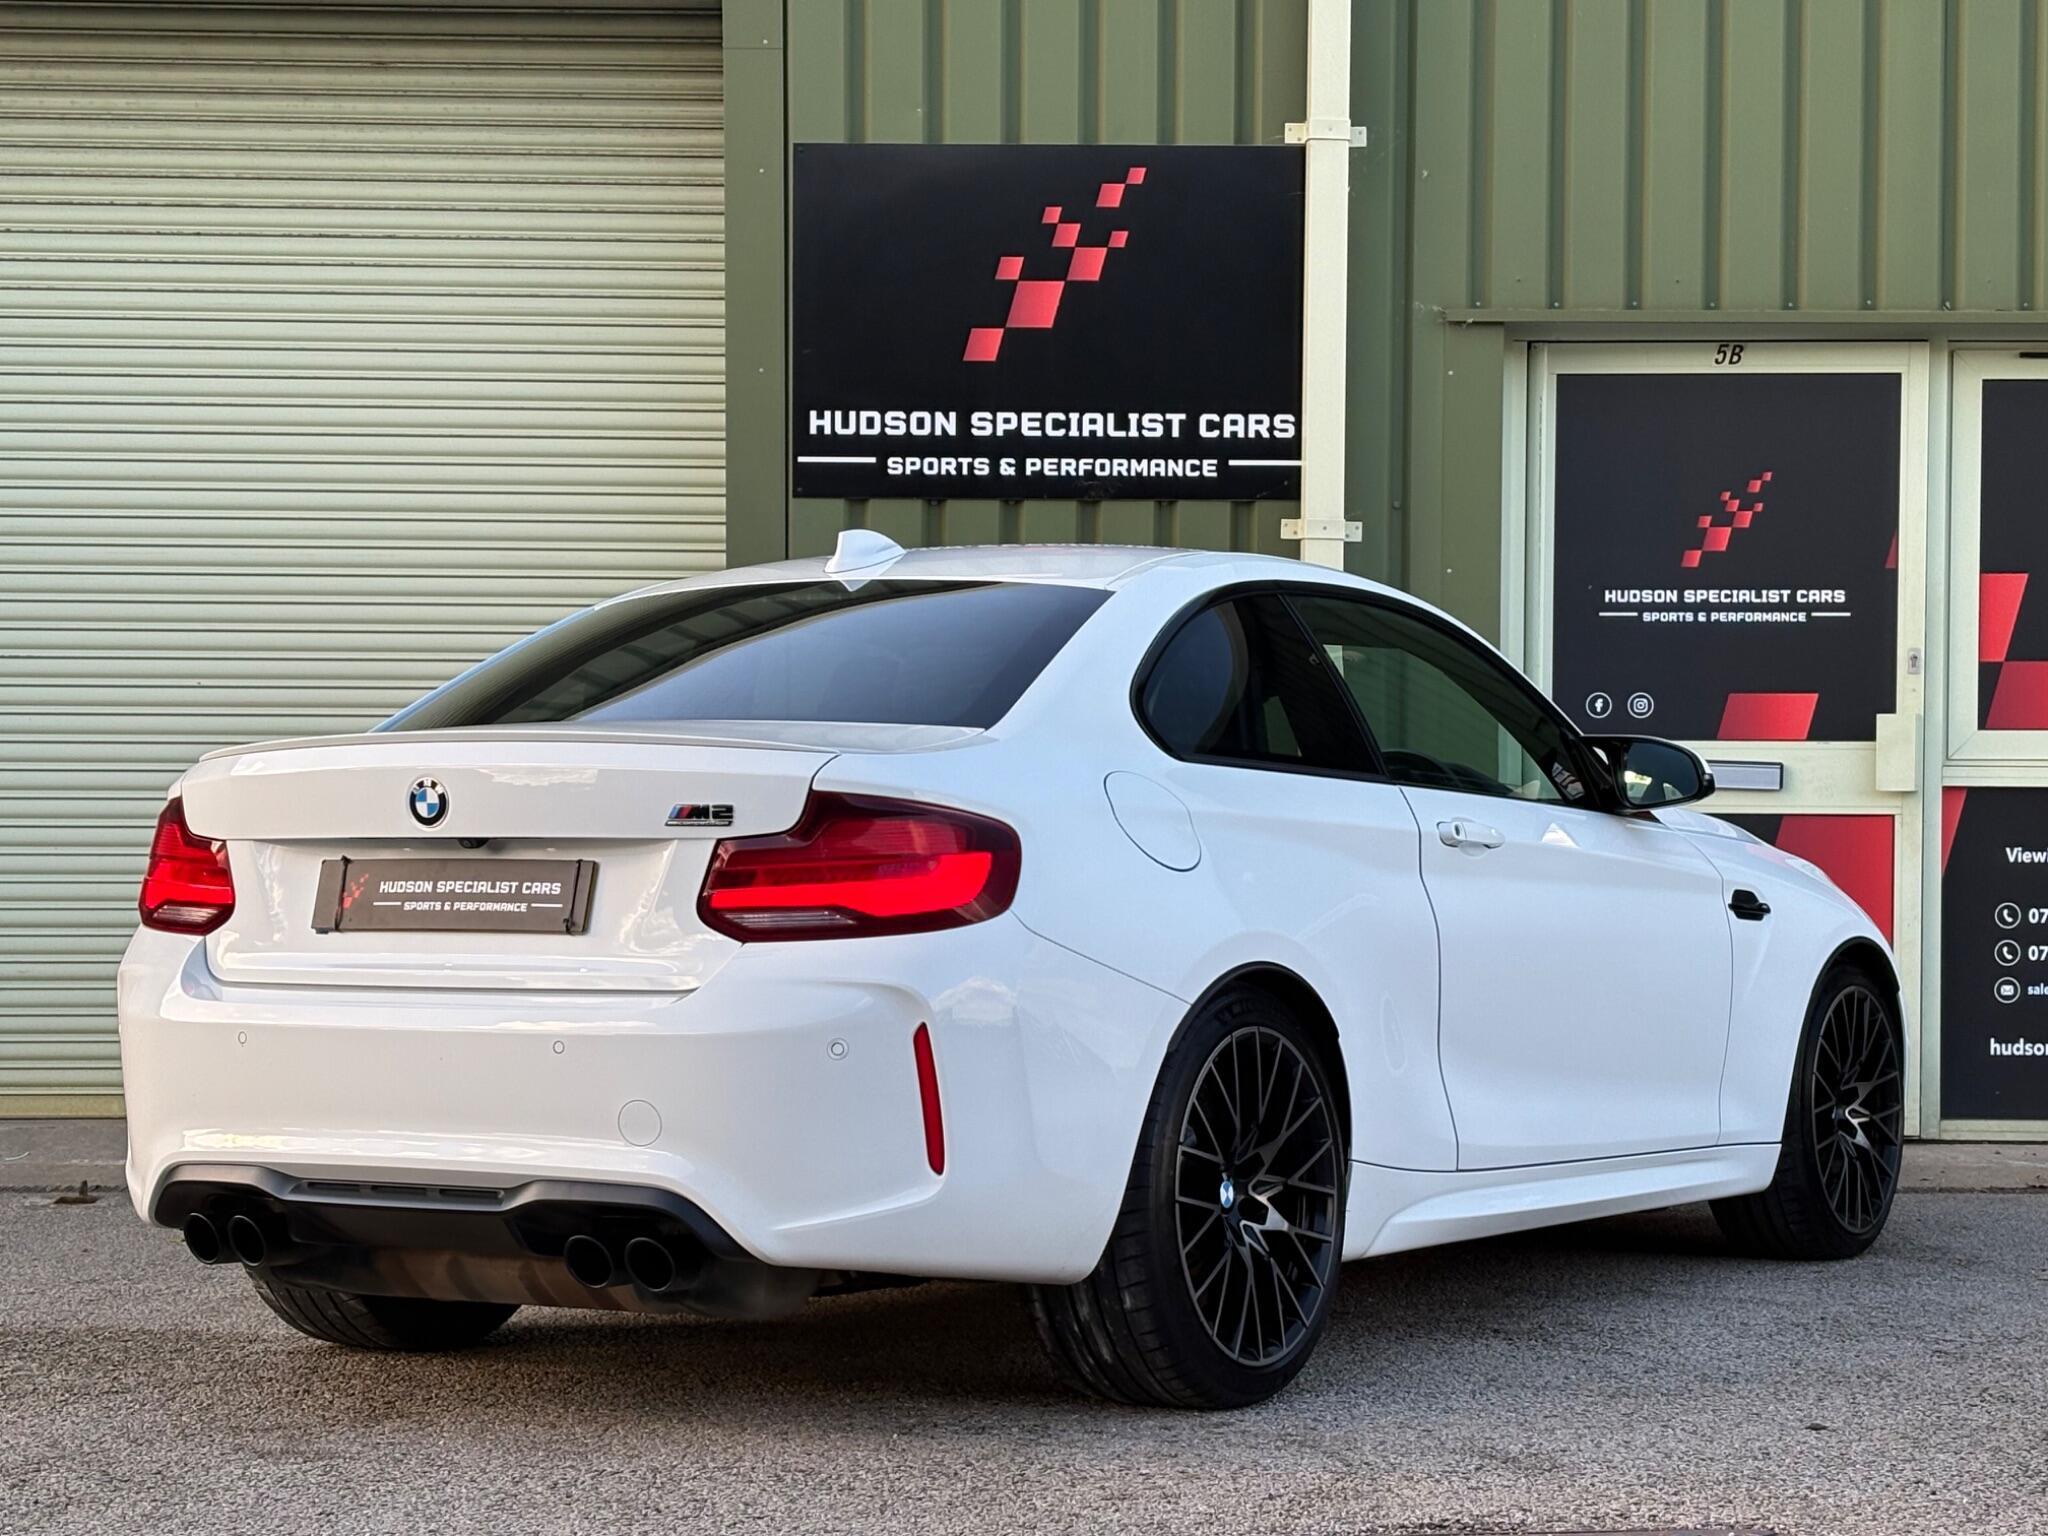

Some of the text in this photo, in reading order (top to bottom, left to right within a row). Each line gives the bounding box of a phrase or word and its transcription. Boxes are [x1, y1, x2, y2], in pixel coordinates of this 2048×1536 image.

[1714, 343, 1744, 365] 5B
[809, 409, 1296, 439] HUDSON SPECIALIST CARS
[886, 456, 1218, 478] SPORTS & PERFORMANCE
[1604, 589, 1846, 604] HUDSON SPECIALIST CARS
[1642, 611, 1807, 623] SPORTS & PERFORMANCE
[668, 804, 734, 819] M2
[378, 880, 562, 895] HUDSON SPECIALIST CARS
[403, 901, 528, 912] SPORTS & PERFORMANCE
[2028, 907, 2048, 924] 07
[2027, 945, 2048, 961] 07
[1989, 1037, 2048, 1056] hudso
